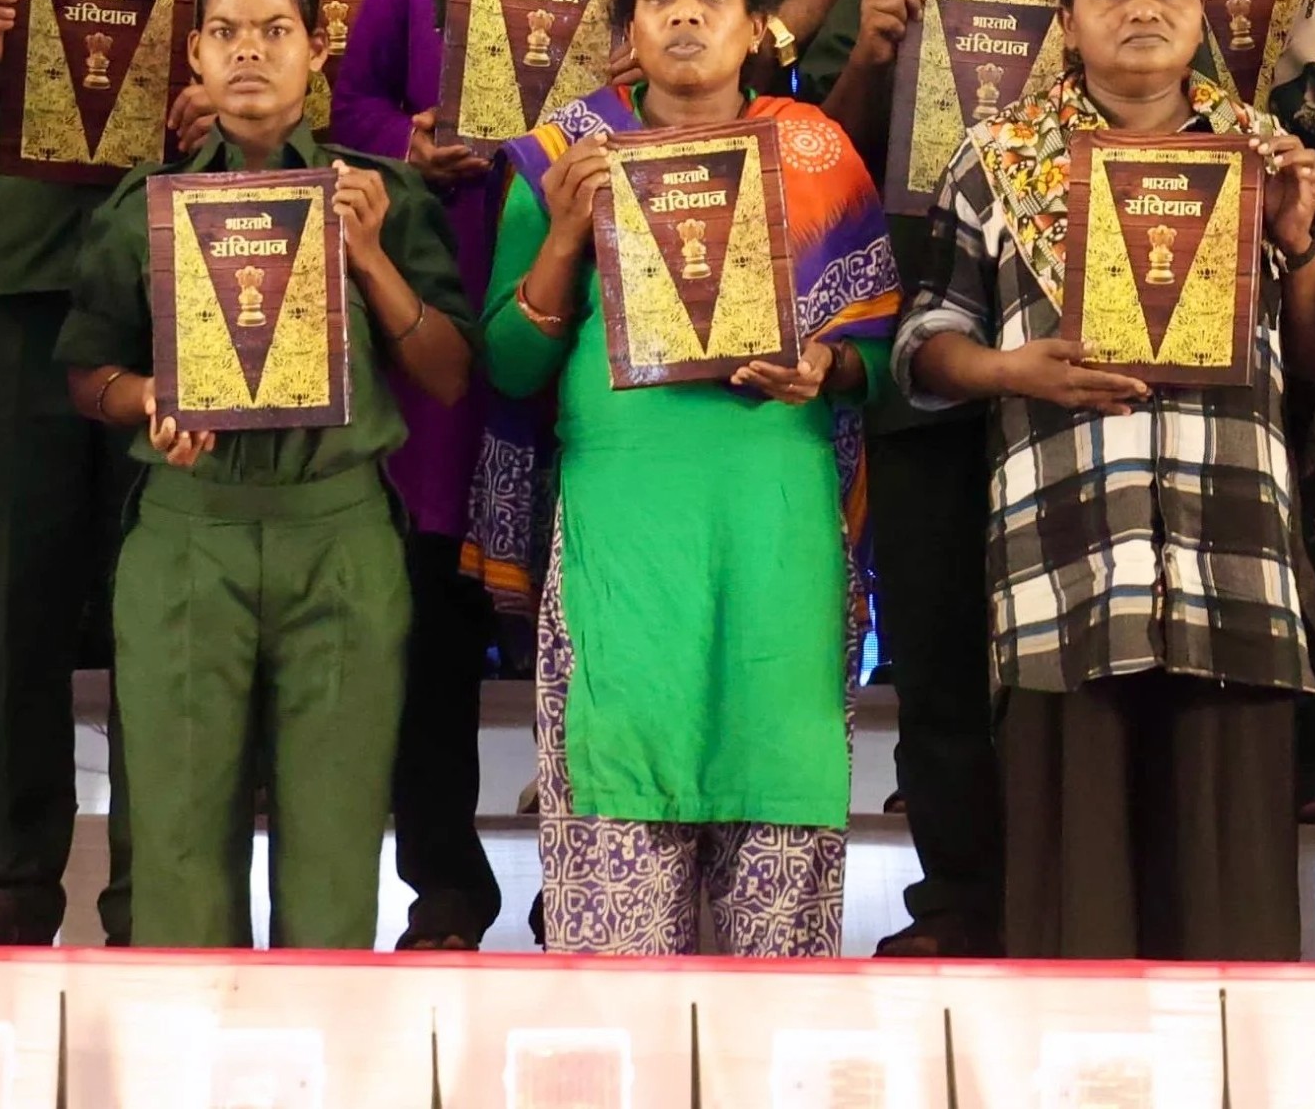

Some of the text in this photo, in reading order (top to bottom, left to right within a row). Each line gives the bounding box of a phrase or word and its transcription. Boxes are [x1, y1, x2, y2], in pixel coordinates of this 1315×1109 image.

[65, 3, 136, 25] संविधान
[956, 33, 1028, 56] संविधान
[649, 190, 726, 212] संविधान
[1125, 194, 1202, 216] संविधान
[210, 235, 287, 257] संविधान
